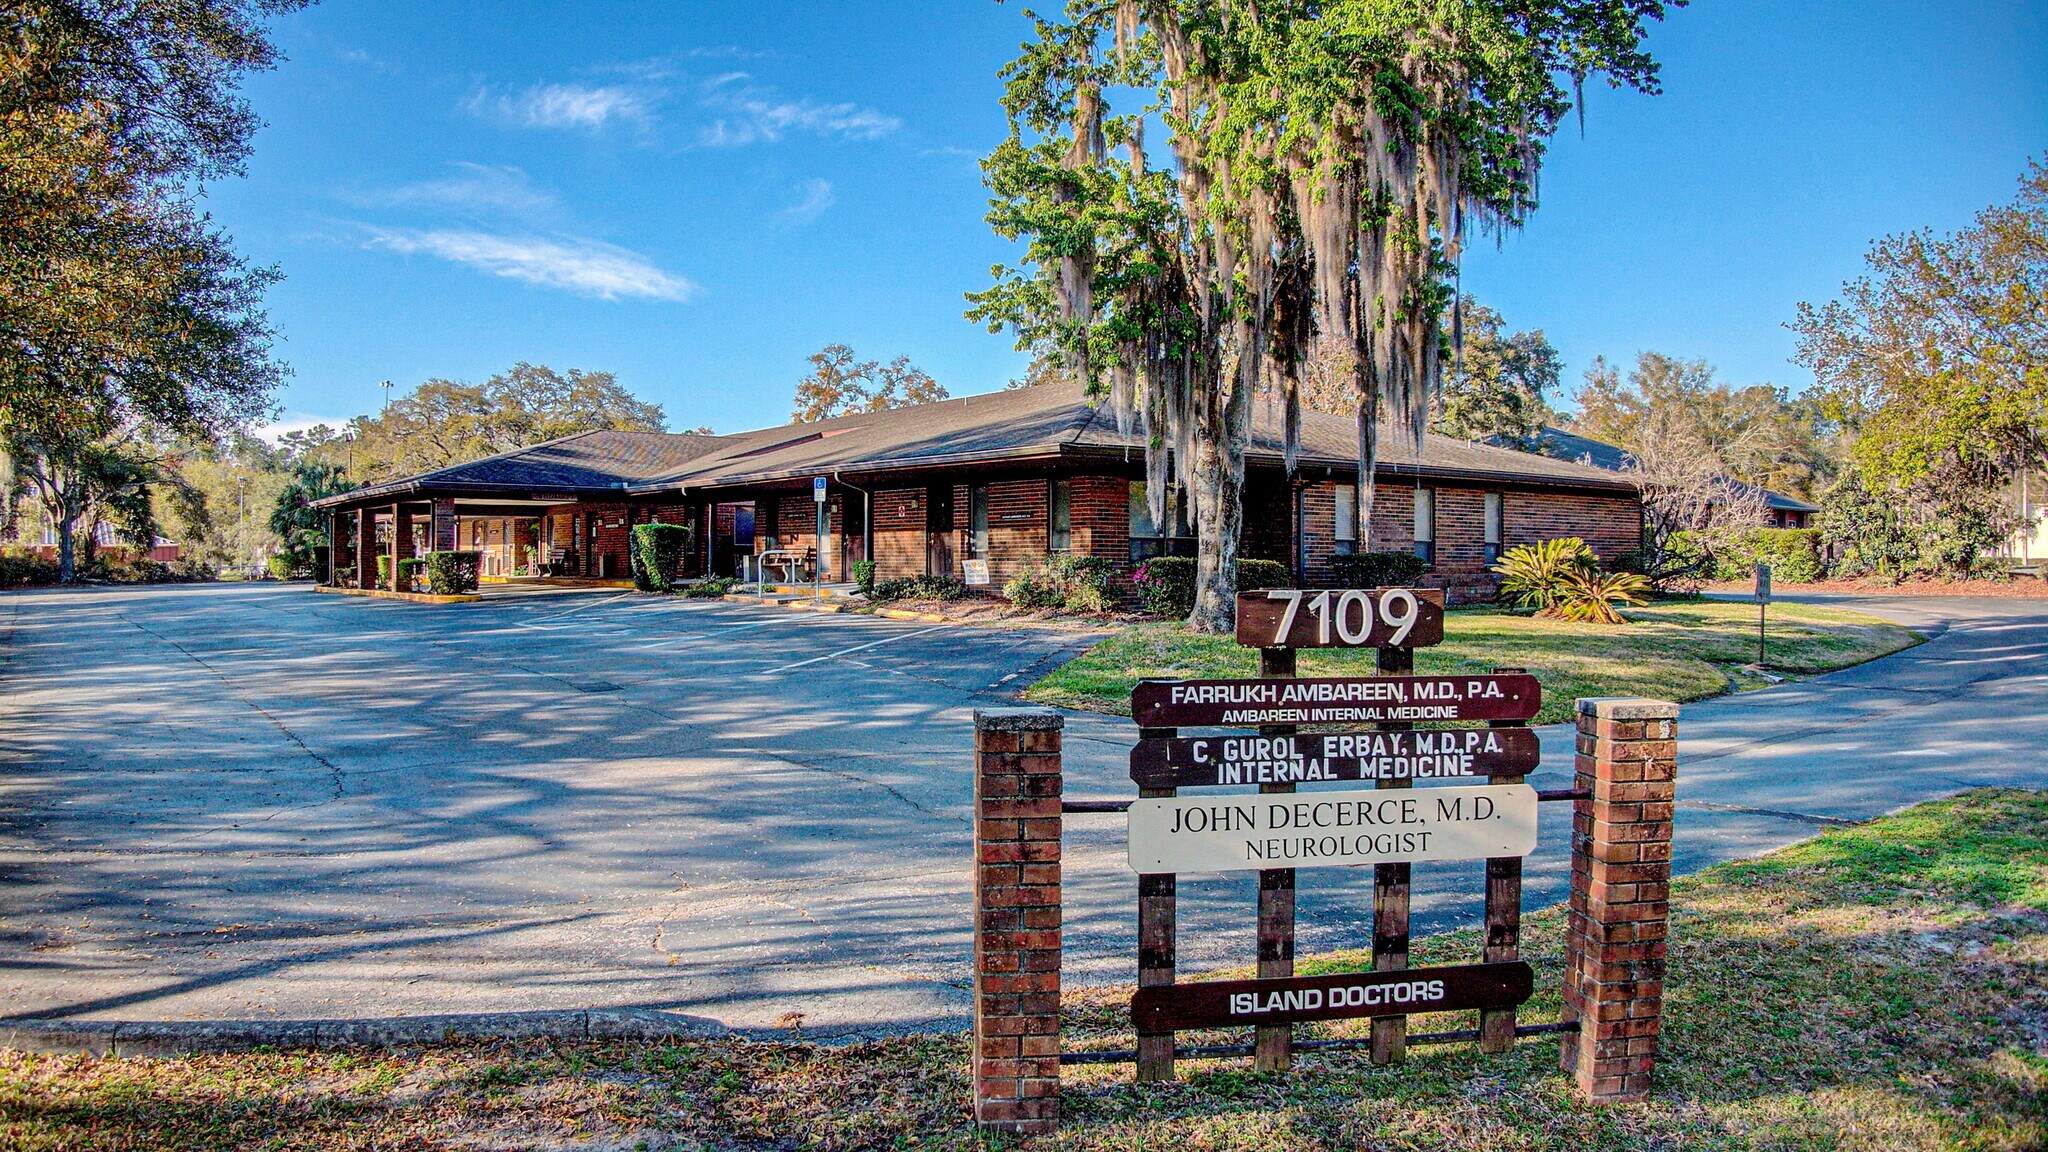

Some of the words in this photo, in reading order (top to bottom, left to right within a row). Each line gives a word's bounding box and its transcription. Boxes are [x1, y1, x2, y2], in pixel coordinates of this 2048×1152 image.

[1267, 589, 1418, 646] 7109
[1171, 684, 1277, 704] FARRUKH
[1282, 682, 1408, 702] AMBAREEN,
[1413, 682, 1463, 701] M.D.,
[1468, 680, 1505, 699] P.A.
[1221, 709, 1308, 723] AMBAREEN
[1311, 707, 1384, 721] INTERNAL
[1387, 705, 1458, 720] MEDICINE
[1223, 737, 1304, 761] GUROL
[1323, 733, 1408, 759] ERBAY,
[1218, 758, 1338, 784] INTERNAL
[1360, 755, 1475, 779] MEDICINE
[1170, 804, 1256, 834] JOHN
[1268, 799, 1426, 830] DECERCE,
[1436, 796, 1501, 822] M.D.
[1246, 832, 1433, 860] NEUROLOGIST
[1229, 989, 1323, 1015] ISLAND
[1328, 980, 1444, 1009] DOCTORS
